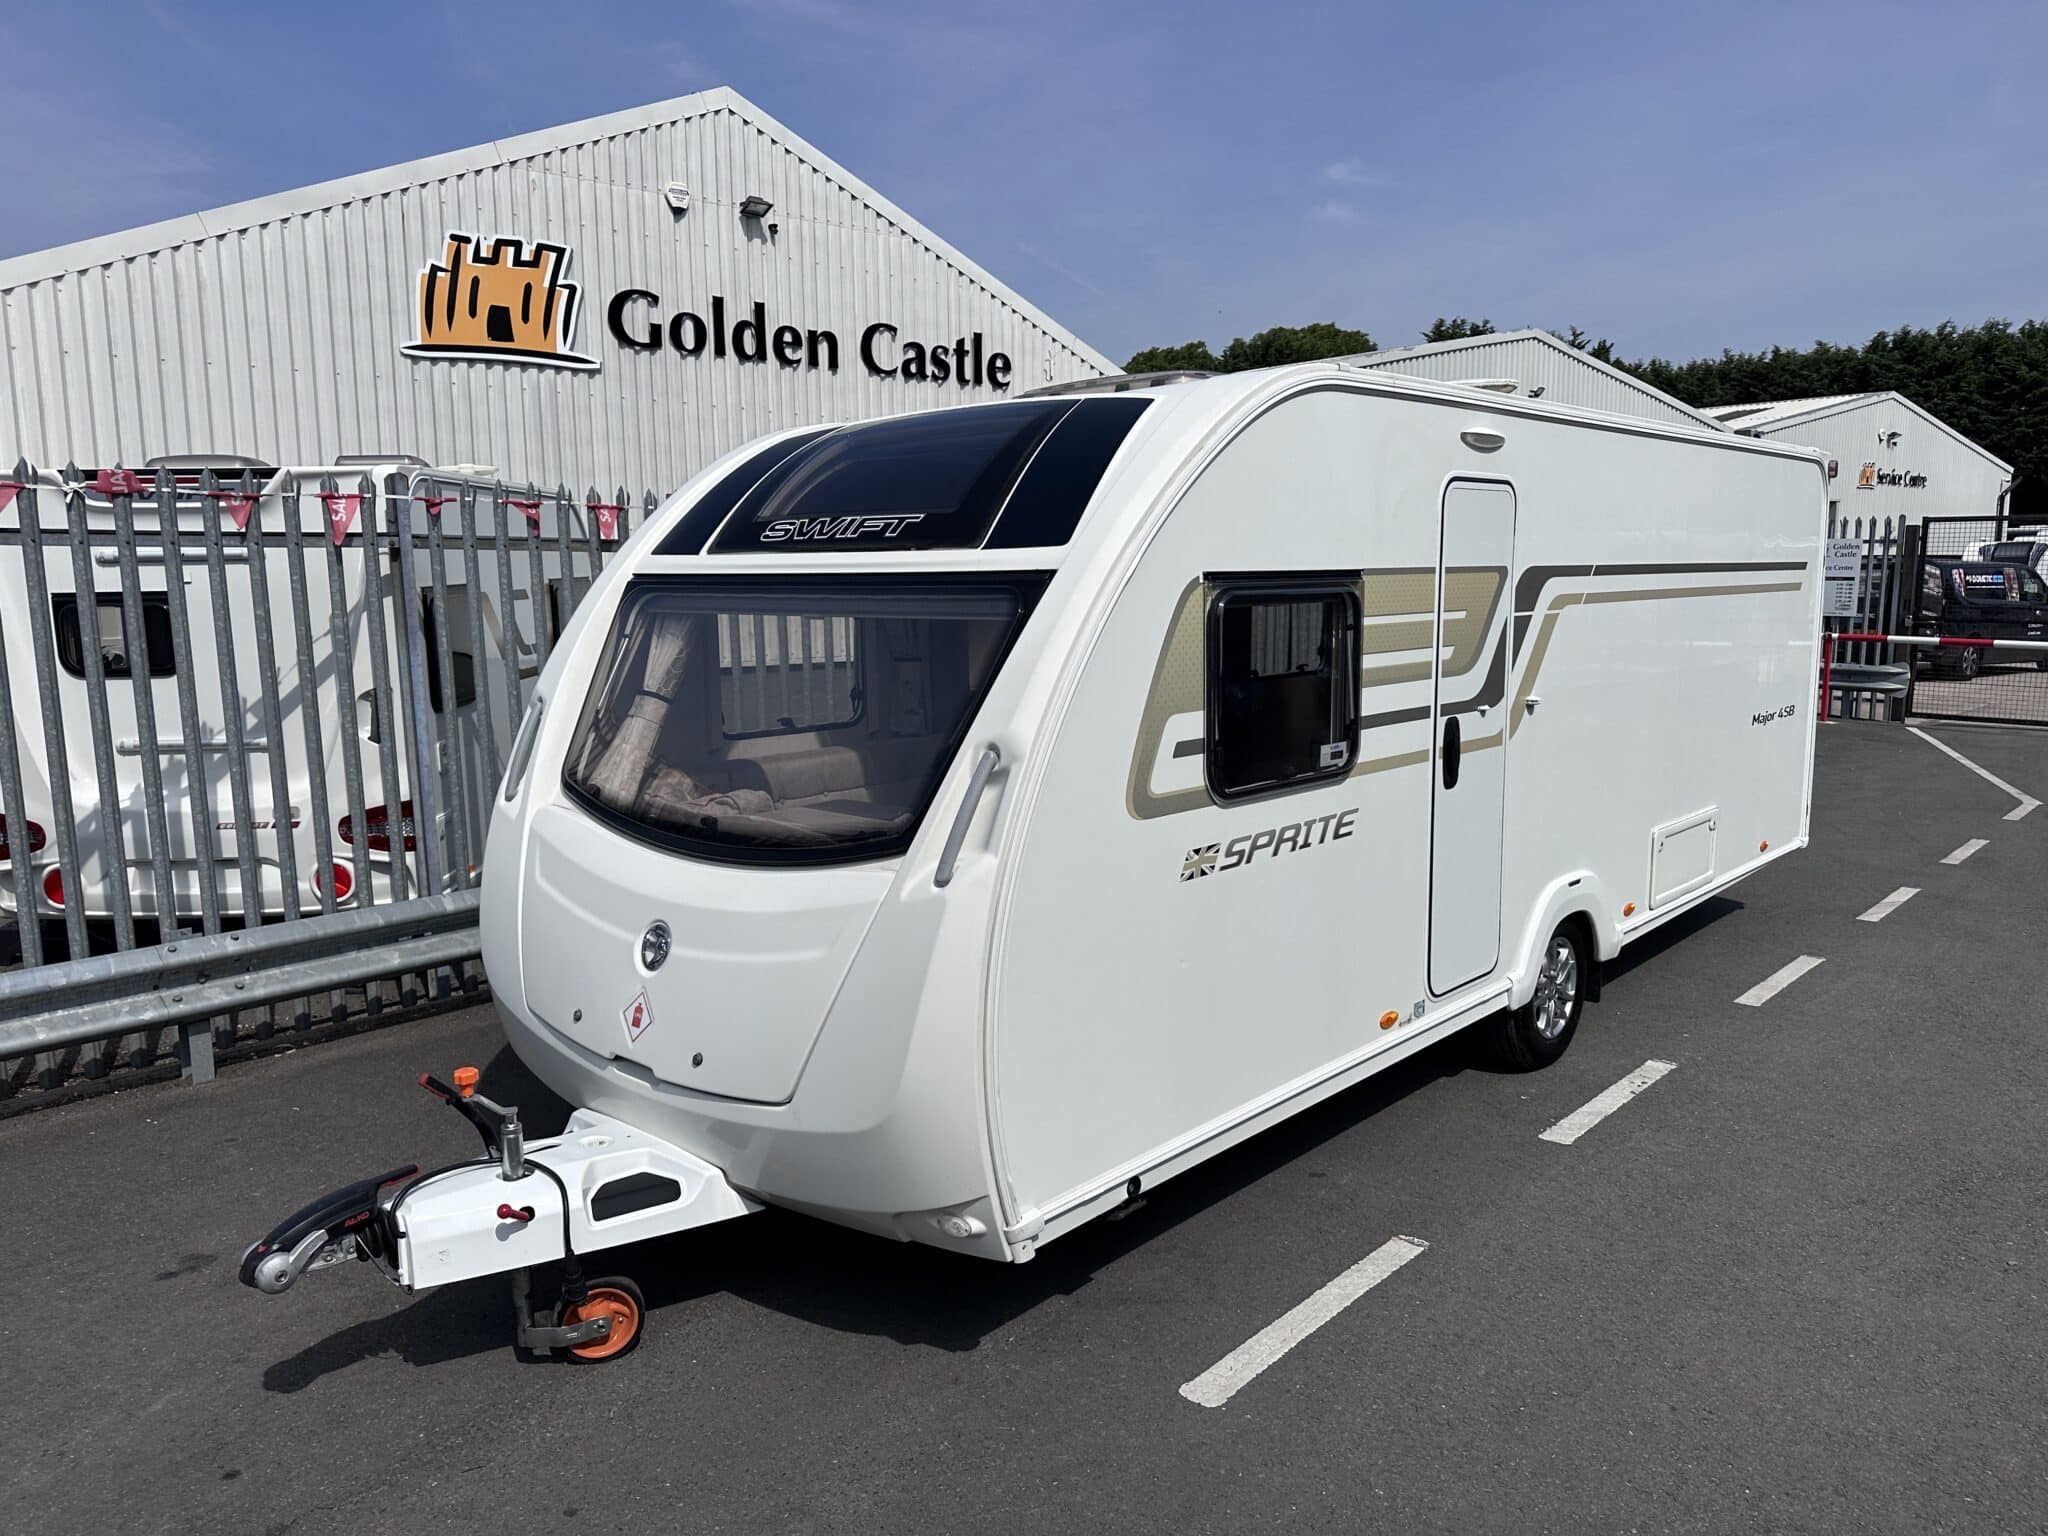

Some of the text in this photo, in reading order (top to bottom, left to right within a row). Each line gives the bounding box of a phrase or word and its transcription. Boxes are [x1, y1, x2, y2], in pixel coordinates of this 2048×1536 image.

[608, 289, 1012, 388] Golden Castle
[1877, 468, 1928, 488] Service Centre
[760, 513, 926, 542] SWIFT
[1834, 550, 1857, 558] Castle
[1751, 710, 1777, 726] Major
[1219, 808, 1359, 871] SPRITE
